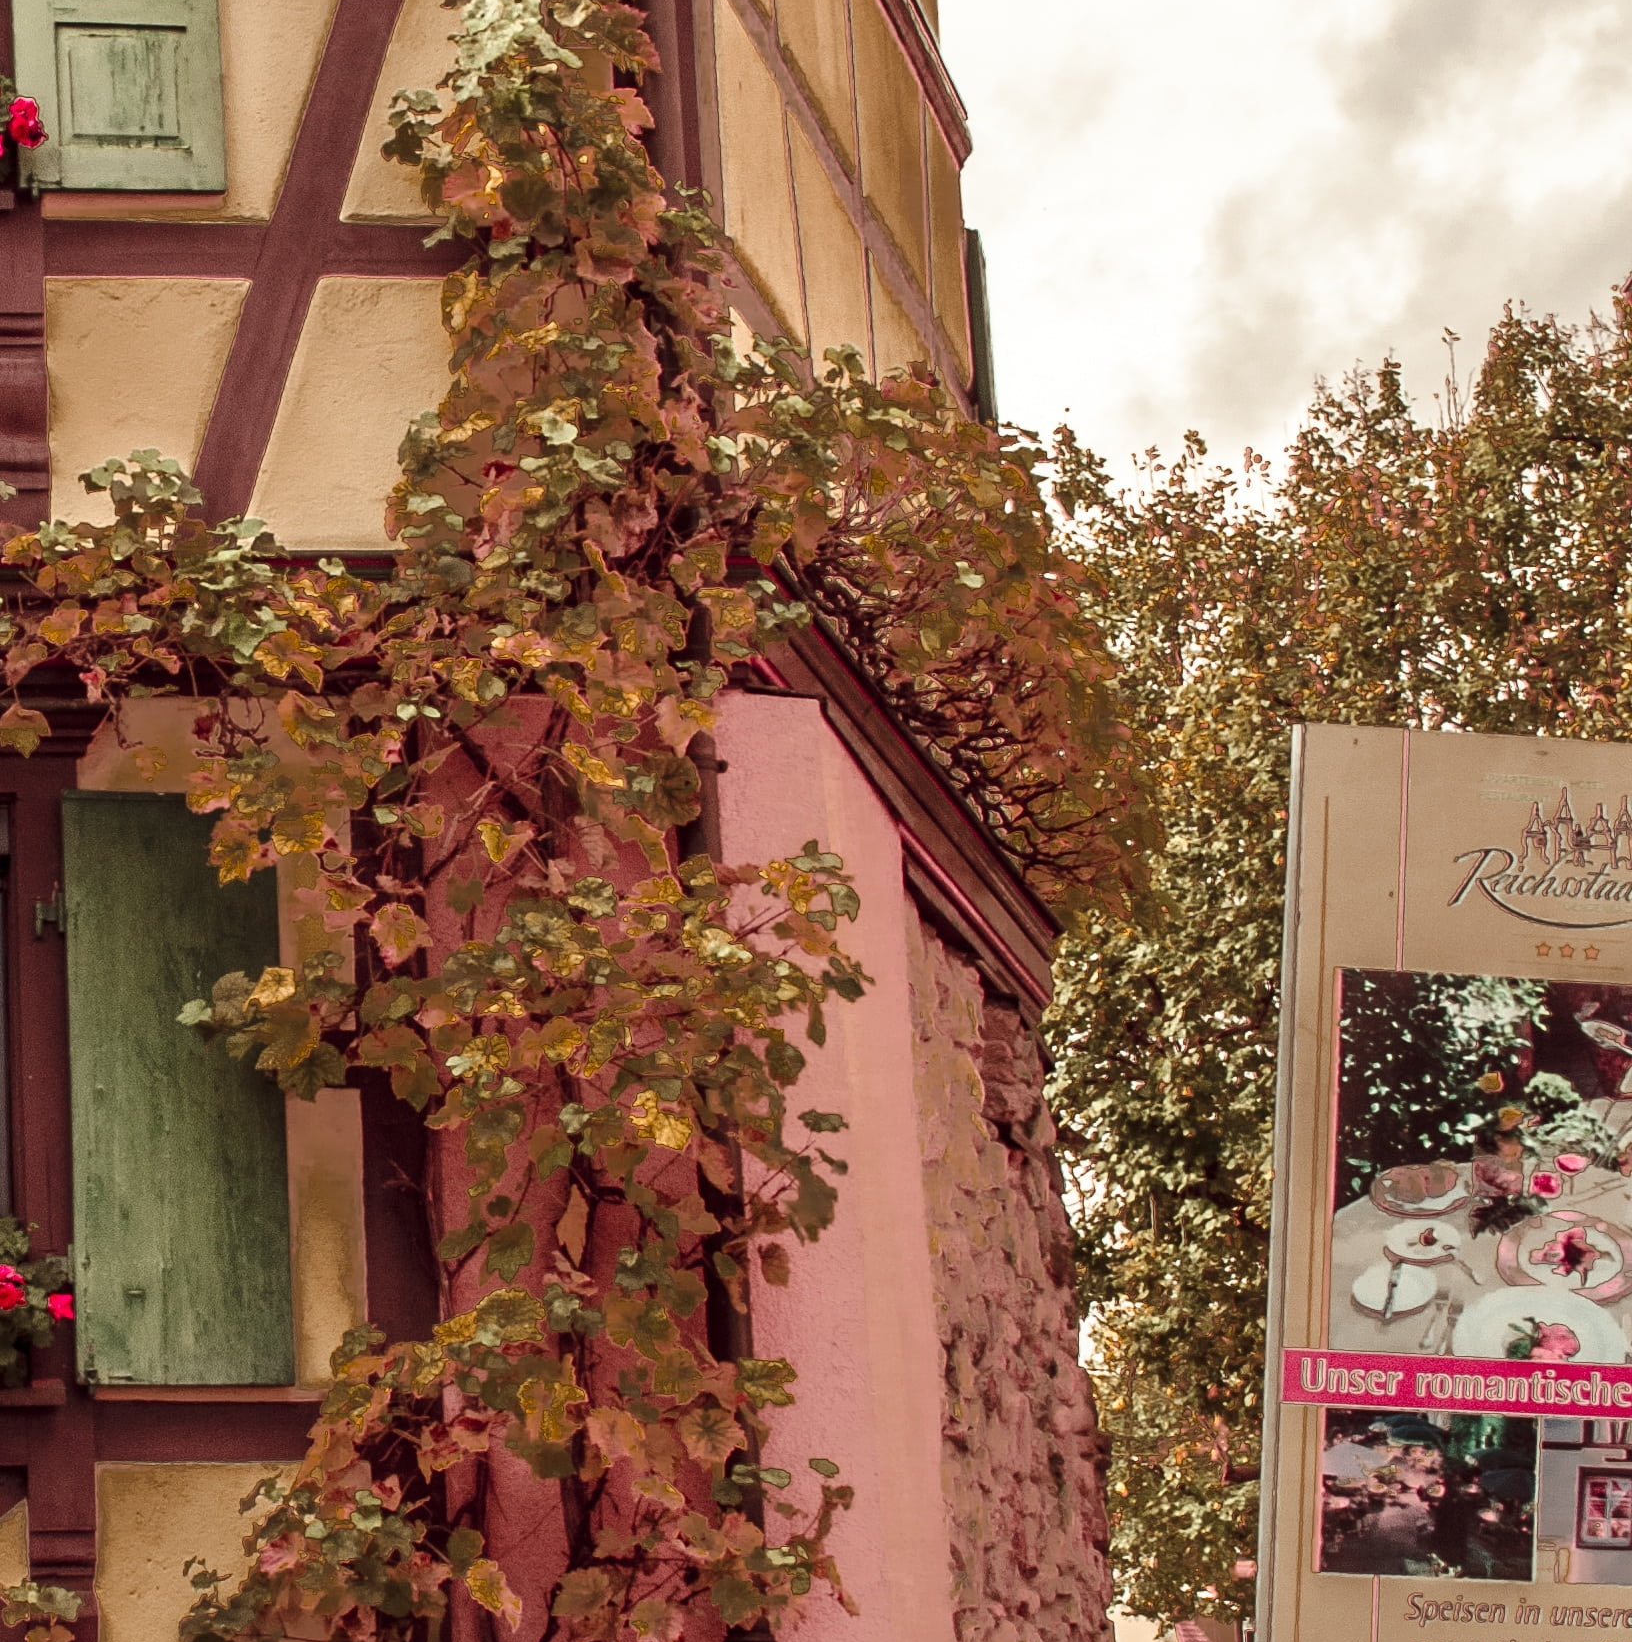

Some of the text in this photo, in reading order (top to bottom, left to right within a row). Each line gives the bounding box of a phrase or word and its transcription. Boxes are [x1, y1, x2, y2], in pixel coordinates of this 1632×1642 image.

[1300, 1357, 1632, 1407] Unser romantische
[1403, 1591, 1506, 1627] Speisen
[1515, 1597, 1541, 1625] in
